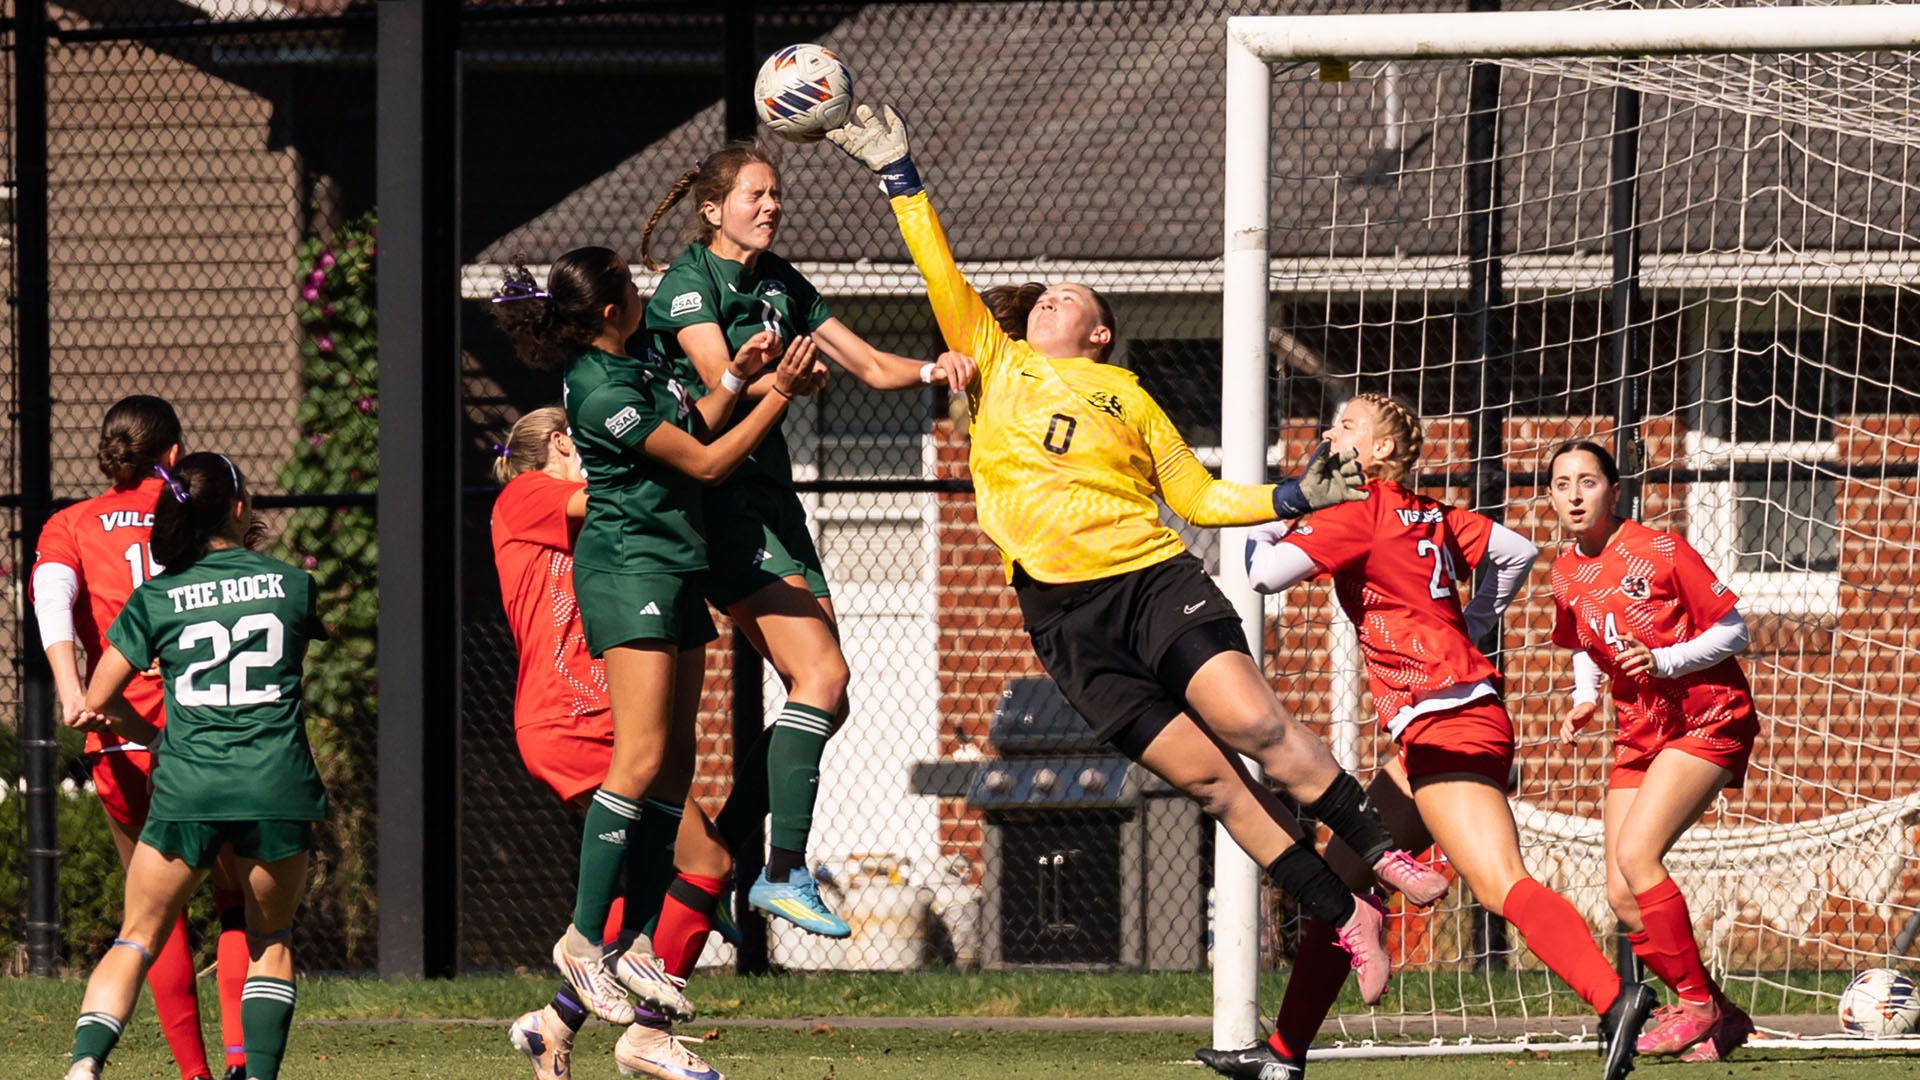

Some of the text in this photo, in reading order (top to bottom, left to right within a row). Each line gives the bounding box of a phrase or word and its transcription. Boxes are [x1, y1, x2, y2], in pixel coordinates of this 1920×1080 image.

[609, 409, 637, 433] PSAC
[1043, 413, 1077, 455] 0
[97, 510, 155, 532] VULC
[167, 573, 286, 613] THE ROCK
[175, 612, 284, 706] 22
